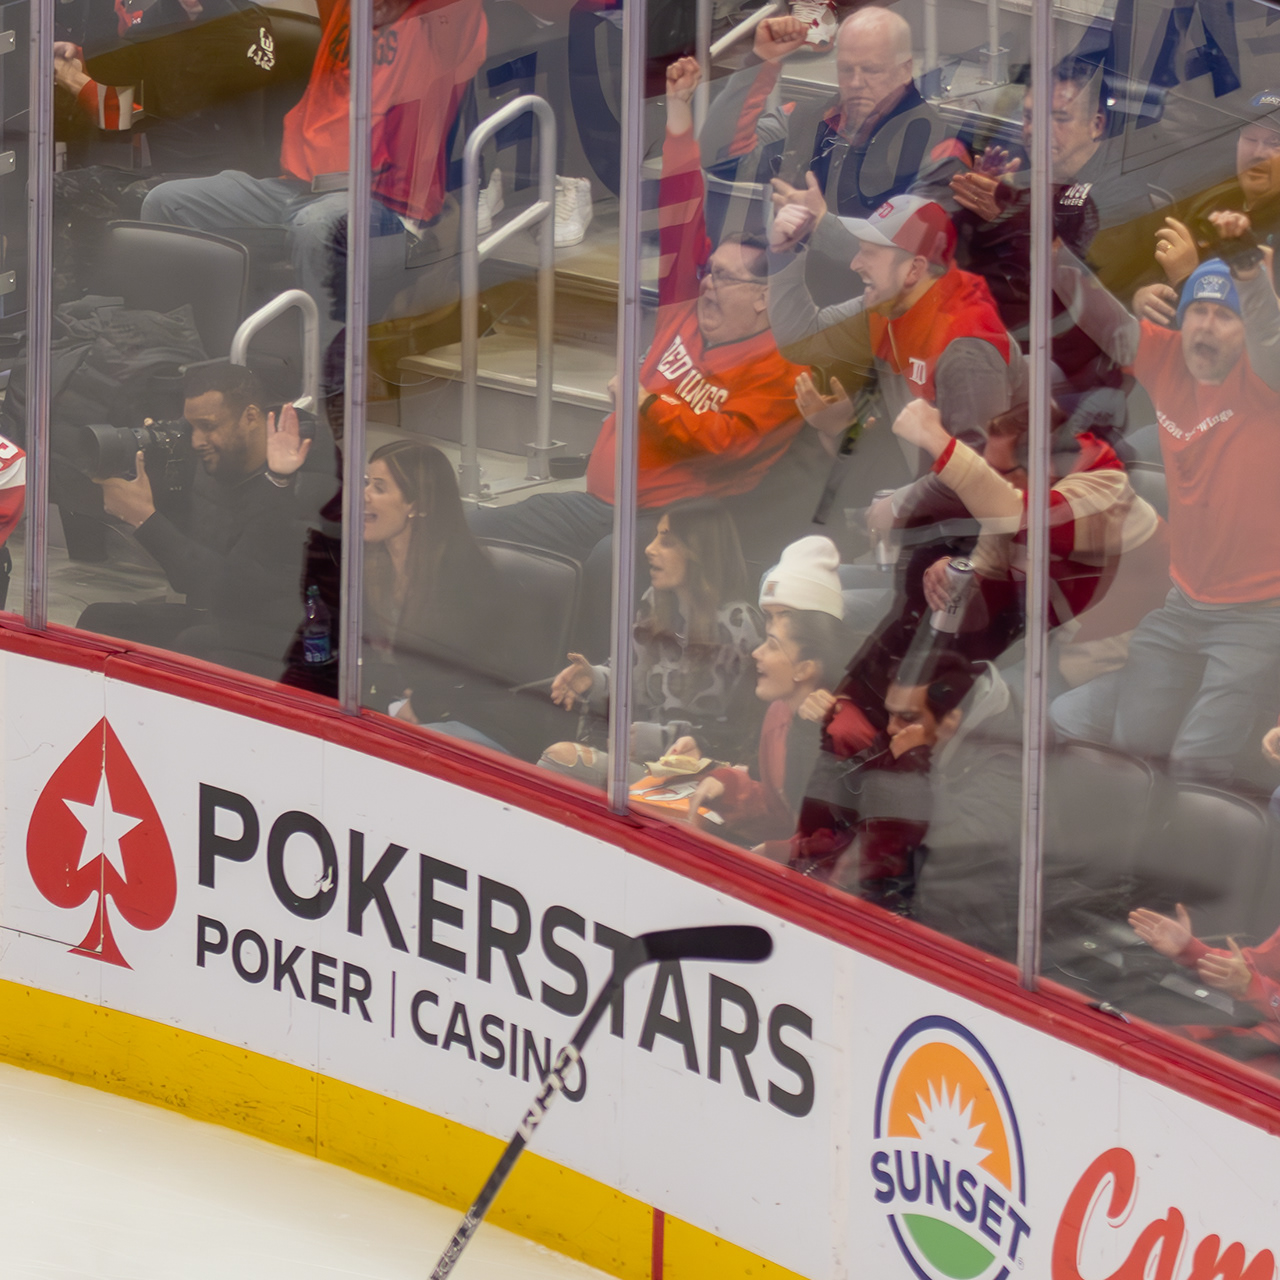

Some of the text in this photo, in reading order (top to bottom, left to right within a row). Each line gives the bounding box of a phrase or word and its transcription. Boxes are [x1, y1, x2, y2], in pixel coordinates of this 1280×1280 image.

[196, 915, 589, 1103] POKER CASINO
[197, 781, 816, 1119] POKERSTARS
[870, 1149, 1032, 1263] SUNSET
